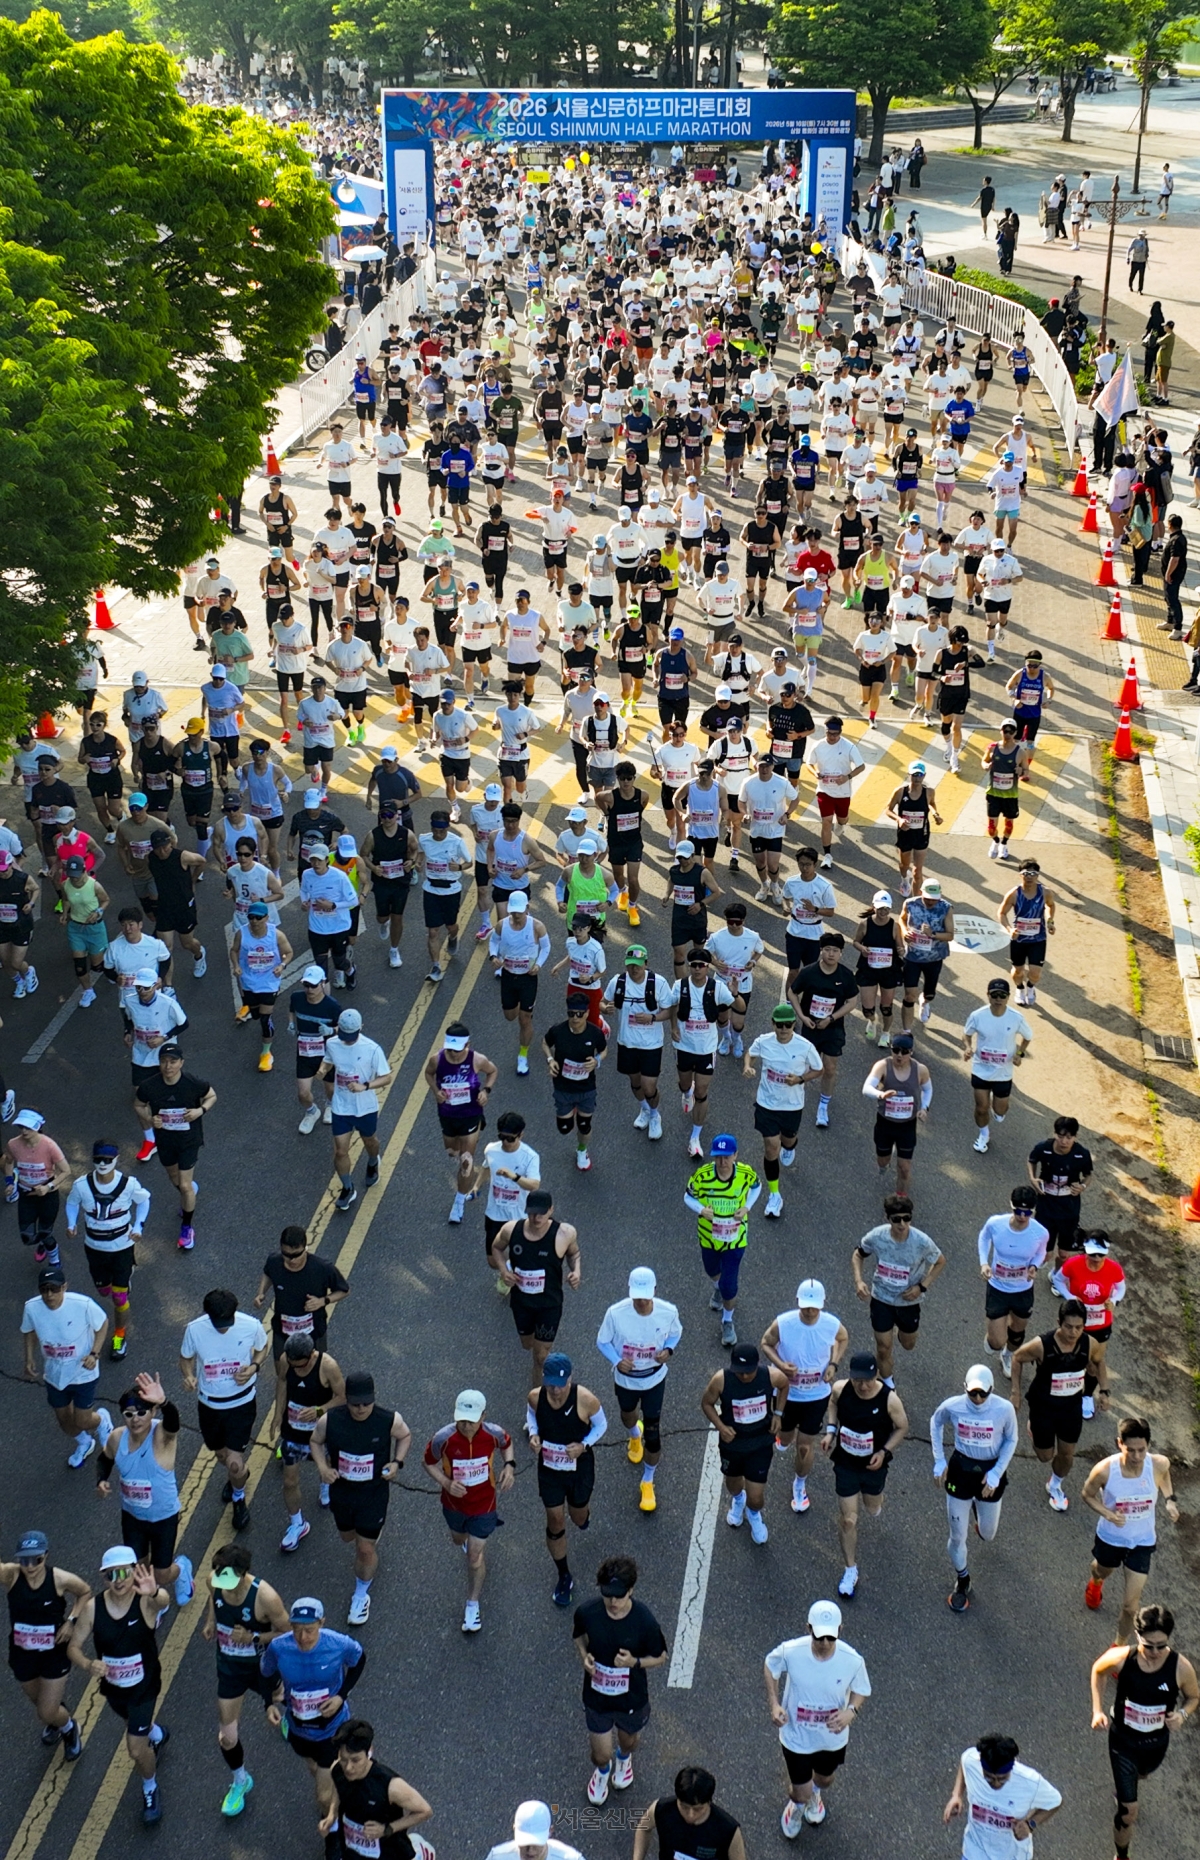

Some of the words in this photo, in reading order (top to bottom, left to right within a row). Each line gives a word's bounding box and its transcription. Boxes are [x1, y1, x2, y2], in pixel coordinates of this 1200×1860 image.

[497, 98, 547, 117] 2026
[553, 97, 752, 118] 서울신문하프마라톤대회
[497, 122, 546, 136] SEOUL
[550, 122, 620, 136] SHINMUN
[624, 122, 662, 136] HALF
[667, 122, 752, 136] MARATHON
[716, 717, 722, 726] S
[203, 751, 209, 760] S
[241, 884, 250, 897] 5
[220, 1367, 238, 1375] 4102
[749, 1407, 763, 1415] 1911
[469, 1468, 485, 1478] 1902
[242, 1608, 251, 1622] S
[119, 1668, 141, 1678] 2272
[988, 1816, 1011, 1829] 2403
[355, 1837, 376, 1848] 2793
